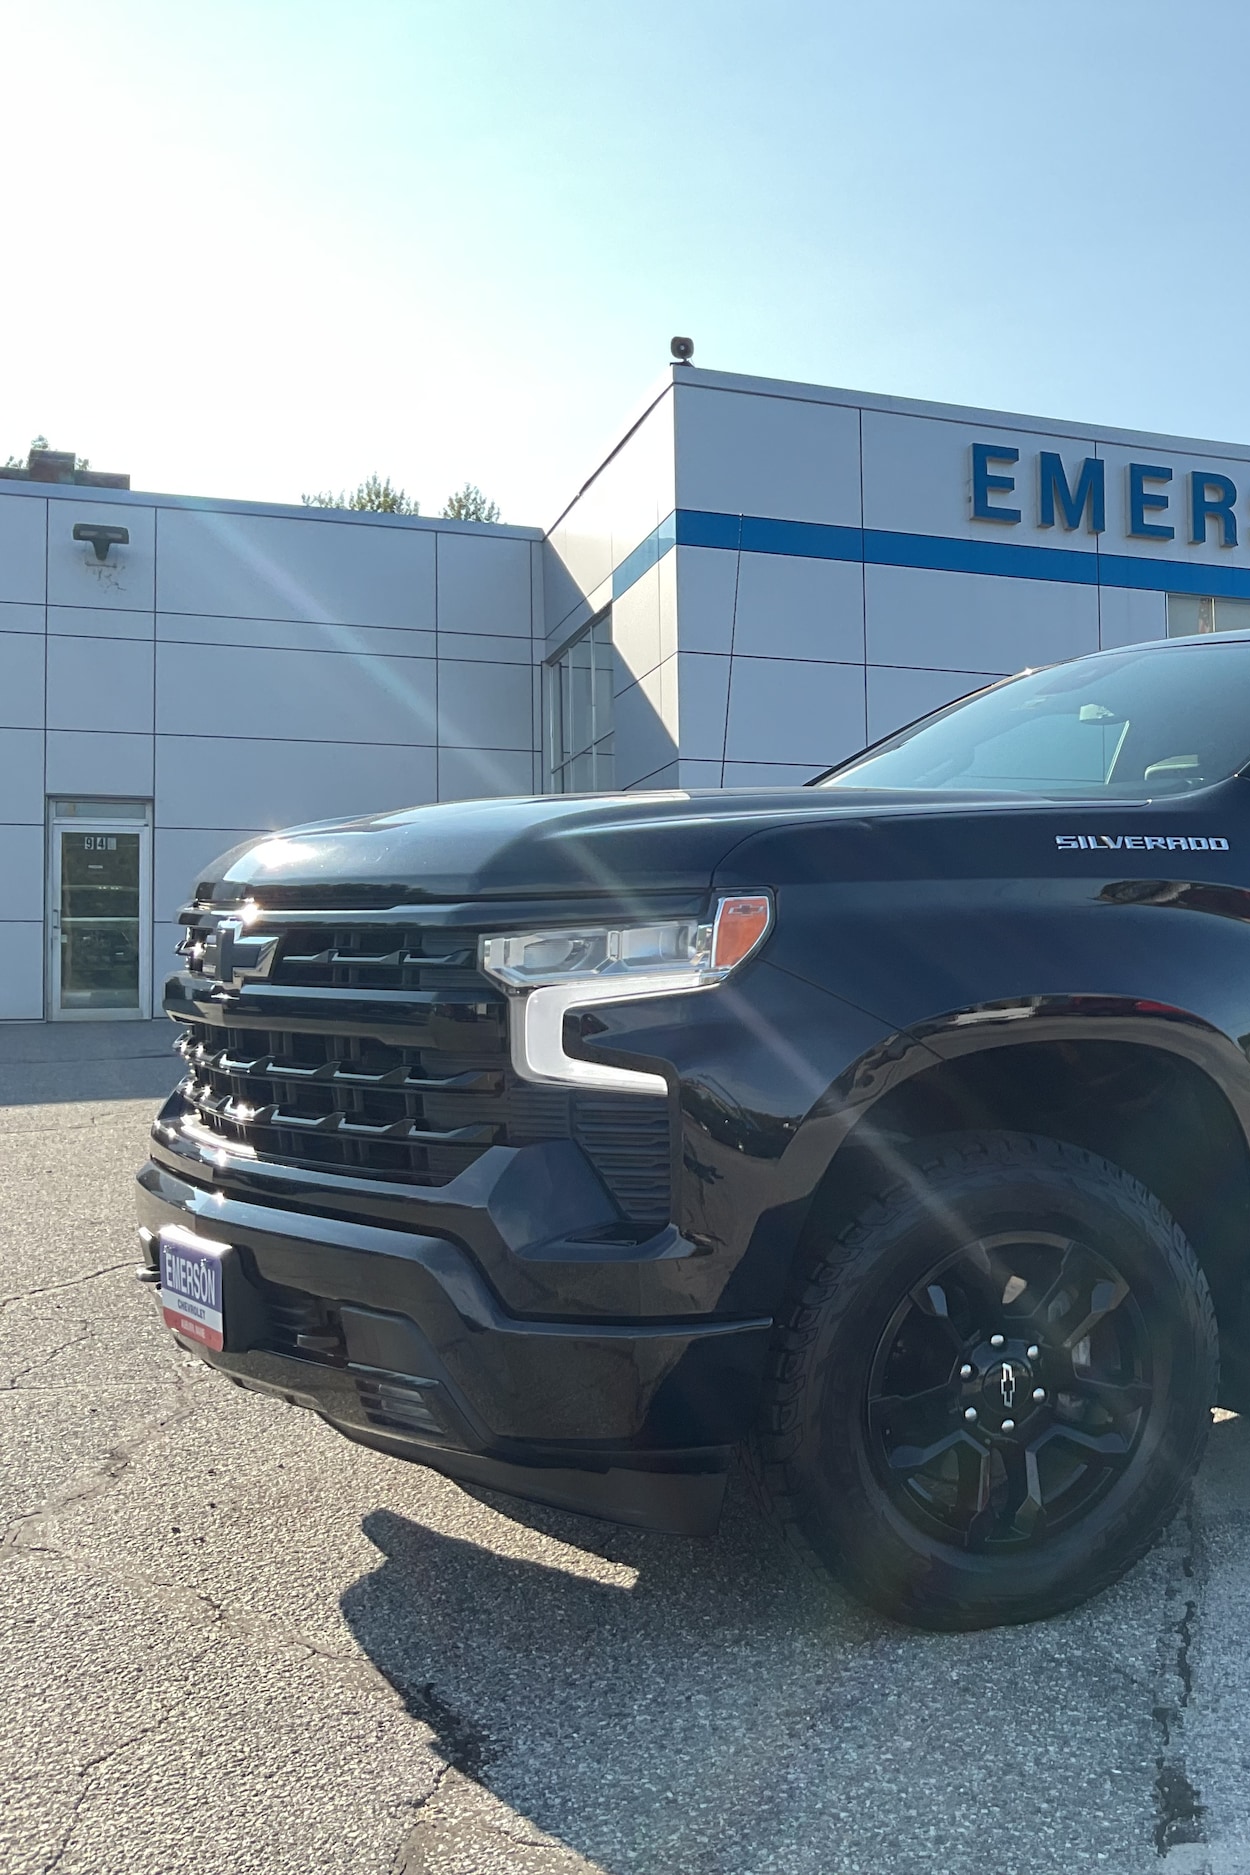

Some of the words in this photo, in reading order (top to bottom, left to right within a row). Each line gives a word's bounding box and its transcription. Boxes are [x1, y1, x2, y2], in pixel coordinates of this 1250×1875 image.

[1055, 835, 1230, 850] SILVERADO
[165, 1252, 216, 1306] EMERSON
[177, 1298, 206, 1321] CHEVROLET
